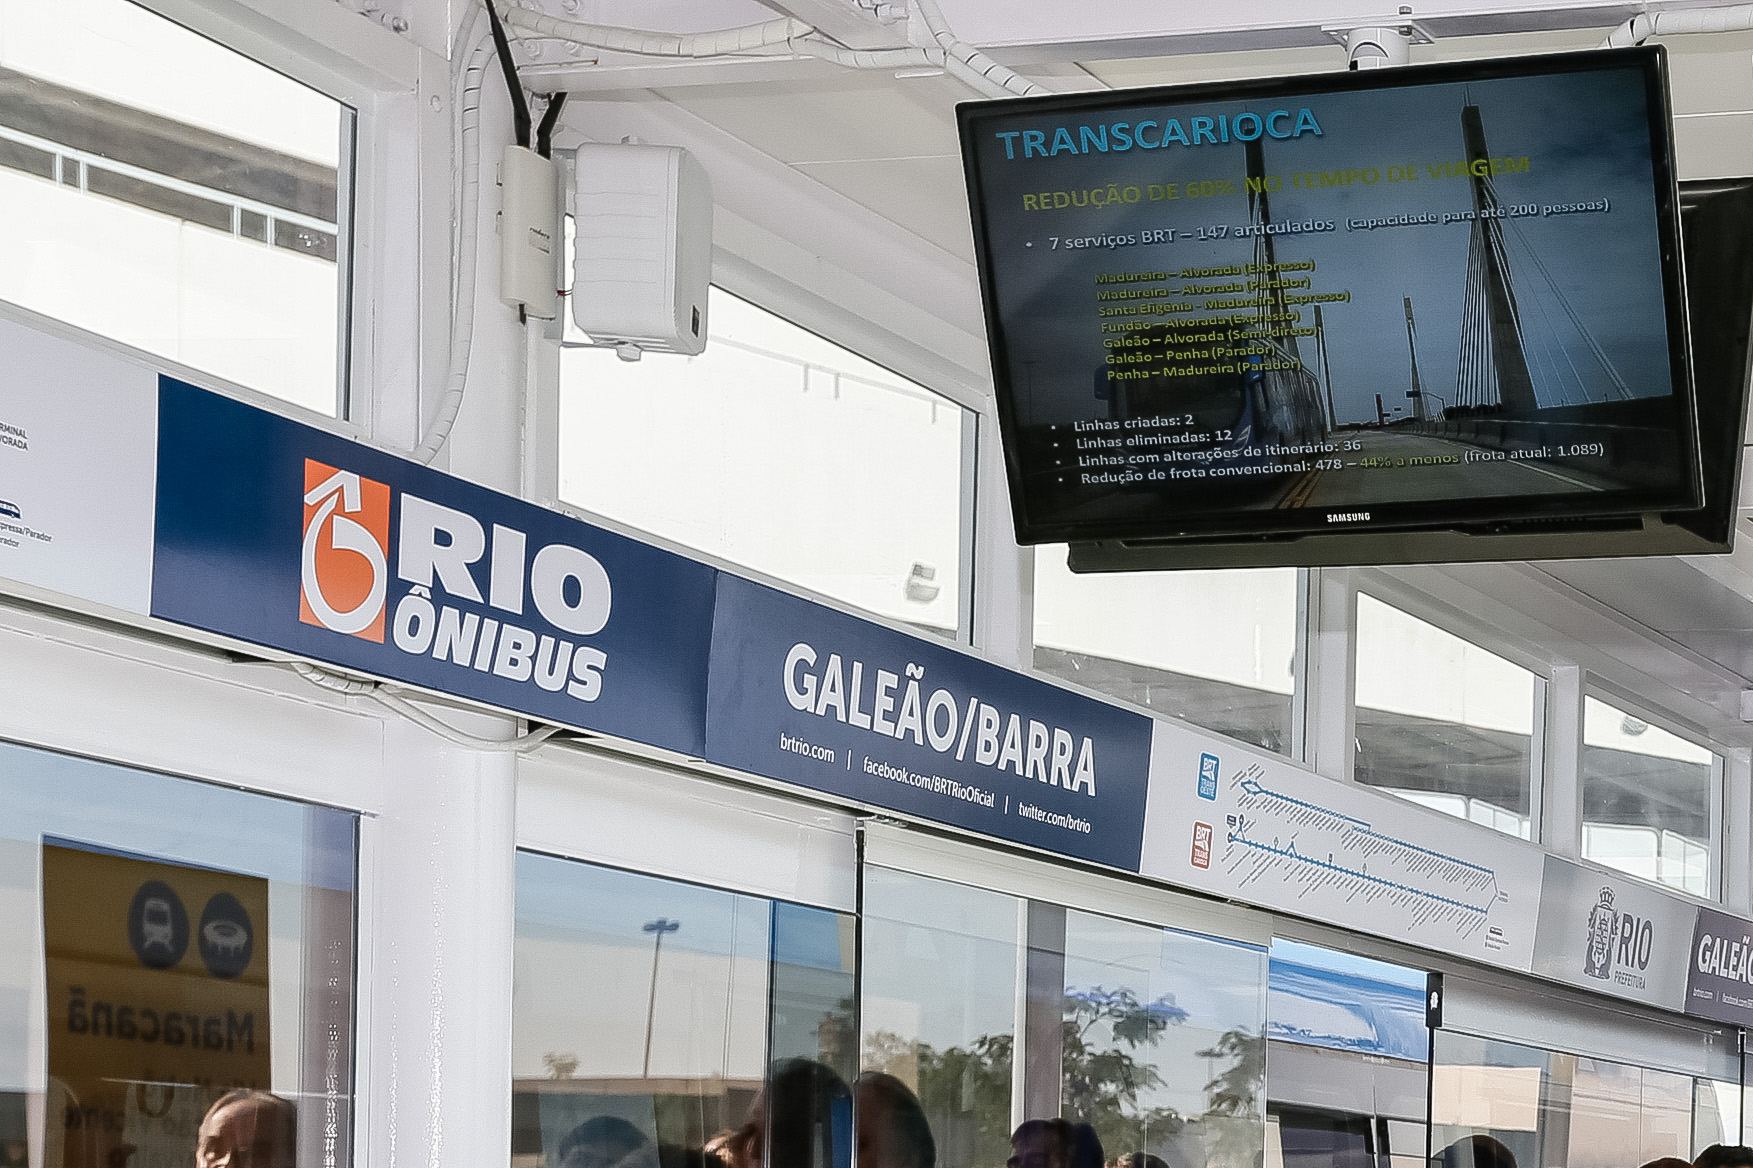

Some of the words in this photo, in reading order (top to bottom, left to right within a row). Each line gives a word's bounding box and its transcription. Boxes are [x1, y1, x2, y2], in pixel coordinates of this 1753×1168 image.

[995, 107, 1323, 160] TRANSCARIOCA
[1021, 183, 1142, 210] REDUÇÃO
[1147, 182, 1180, 201] DE
[1184, 178, 1236, 198] 60%
[1243, 174, 1282, 194] NO
[1290, 166, 1382, 190] TEMPO
[1386, 163, 1418, 183] DE
[1428, 155, 1531, 180] VIAGEM
[1047, 236, 1060, 250] 7
[1064, 232, 1136, 250] serviços
[1140, 228, 1177, 244] BRT
[1195, 224, 1229, 239] 147
[1233, 217, 1334, 237] articulados
[1344, 210, 1437, 231] (capacidade
[1441, 209, 1475, 224] para
[1479, 204, 1506, 219] até
[1508, 202, 1538, 217] 200
[1541, 196, 1610, 217] pessoas)
[1094, 270, 1166, 284] Madureira
[1178, 265, 1241, 278] Alvorada
[1242, 258, 1315, 276] (Expresso)
[1096, 286, 1168, 301] Madureira
[1180, 281, 1243, 295] Alvorada
[1244, 275, 1311, 292] (Parador)
[1098, 305, 1136, 316] Santa
[1203, 296, 1275, 309] Madureira
[1277, 289, 1351, 307] (Expresso)
[1100, 320, 1152, 333] Fundão
[1164, 315, 1226, 329] Alvorada
[1227, 309, 1301, 327] (Expresso)
[1102, 336, 1150, 349] Galeão
[1163, 331, 1225, 345] Alvorada
[1104, 352, 1152, 365] Galeão
[1165, 348, 1209, 361] Penha
[1210, 343, 1276, 359] (Parador)
[1106, 368, 1149, 381] Penha
[1162, 363, 1235, 377] Madureira
[1236, 357, 1302, 374] (Parador)
[1073, 419, 1120, 432] Linhas
[1123, 415, 1181, 429] criadas:
[1184, 414, 1195, 426] 2
[1075, 436, 1122, 450] Linhas
[1126, 431, 1211, 447] eliminadas:
[1214, 429, 1233, 442] 12
[1078, 454, 1124, 467] Linhas
[1128, 453, 1160, 464] com
[1162, 447, 1240, 463] alterações
[1242, 445, 1262, 458] de
[1264, 441, 1339, 456] itinerário:
[1342, 439, 1361, 452] 36
[1080, 469, 1144, 485] Redução
[1146, 468, 1167, 481] de
[1168, 467, 1206, 479] frota
[1208, 460, 1311, 477] convencional:
[1315, 458, 1343, 471] 478
[1358, 455, 1391, 469] 44%
[1395, 457, 1405, 466] a
[1408, 453, 1459, 466] menos
[1463, 450, 1506, 464] (frota
[1509, 446, 1552, 460] atual:
[1556, 442, 1604, 457] 1.089)
[1326, 511, 1371, 523] SAMSUNG
[398, 492, 612, 635] RIO
[393, 584, 607, 703] ÔNIBUS
[783, 643, 1096, 797] GALEÃO/BARRA
[1203, 757, 1217, 772] BRT
[779, 733, 835, 763] brtrio.com
[863, 756, 995, 808] facebook.com/BRTRioOficial
[1018, 801, 1091, 834] twitter.com/brtrio
[1196, 825, 1211, 841] BRT
[1616, 913, 1653, 971] RIO
